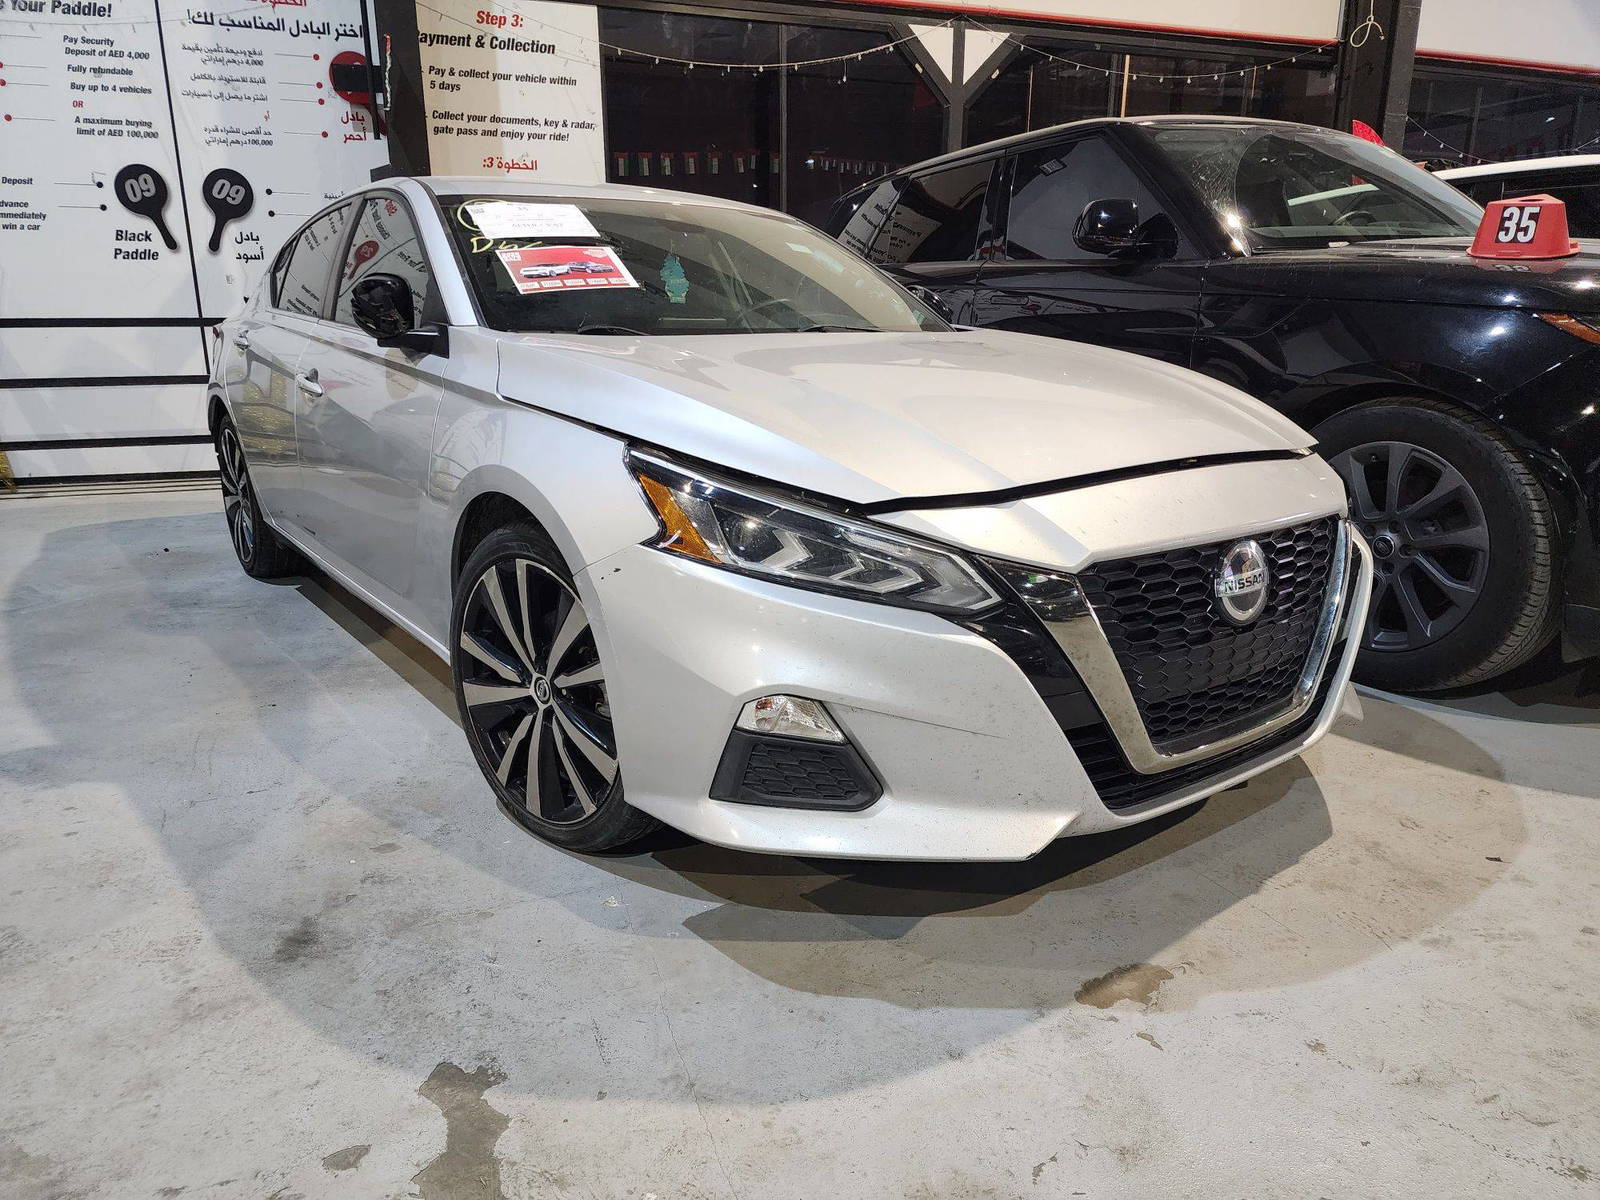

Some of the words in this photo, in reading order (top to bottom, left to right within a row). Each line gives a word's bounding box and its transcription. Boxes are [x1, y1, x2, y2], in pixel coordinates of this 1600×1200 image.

[11, 0, 46, 13] Your
[51, 0, 112, 18] Paddle!
[187, 9, 215, 25] لك!
[219, 13, 285, 31] المناسب
[476, 10, 507, 28] Step
[511, 14, 523, 27] 3:
[289, 20, 330, 39] البادل
[334, 23, 363, 41] اختر
[63, 35, 78, 44] Pay
[81, 36, 114, 47] Security
[419, 32, 471, 49] ayment
[475, 35, 485, 48] &
[490, 36, 555, 54] Collection
[65, 47, 96, 56] Deposit
[109, 50, 124, 58] AED
[67, 64, 87, 74] Fully
[89, 67, 133, 76] refundable
[429, 66, 446, 77] Pay
[449, 66, 455, 76] &
[458, 67, 489, 79] collect
[492, 72, 512, 82] your
[515, 72, 547, 84] vehicle
[549, 75, 577, 86] within
[70, 82, 86, 92] Buy
[119, 86, 152, 94] vehicles
[430, 81, 436, 89] 5
[439, 81, 461, 91] days
[125, 118, 152, 127] buying
[341, 111, 365, 125] بادل
[432, 110, 464, 121] Collect
[467, 113, 487, 124] your
[490, 114, 541, 127] documents,
[544, 117, 559, 128] key
[562, 119, 568, 127] &
[571, 120, 595, 130] radar,
[76, 127, 95, 135] limit
[127, 129, 159, 138] 100,000
[343, 126, 366, 144] أحمر
[433, 125, 454, 135] gate
[456, 127, 478, 137] pass
[481, 127, 497, 137] and
[500, 129, 524, 140] enjoy
[527, 132, 546, 141] your
[549, 132, 569, 141] ride!
[496, 157, 537, 173] الخطوة
[2, 177, 33, 185] Deposit
[125, 174, 156, 202] 09
[211, 179, 246, 205] 09
[0, 212, 46, 221] mmediately
[1498, 207, 1540, 243] 35
[115, 230, 152, 242] Black
[235, 232, 260, 244] بادل
[114, 248, 159, 260] Paddle
[236, 246, 264, 263] أسود
[1224, 573, 1264, 592] NISSAN
